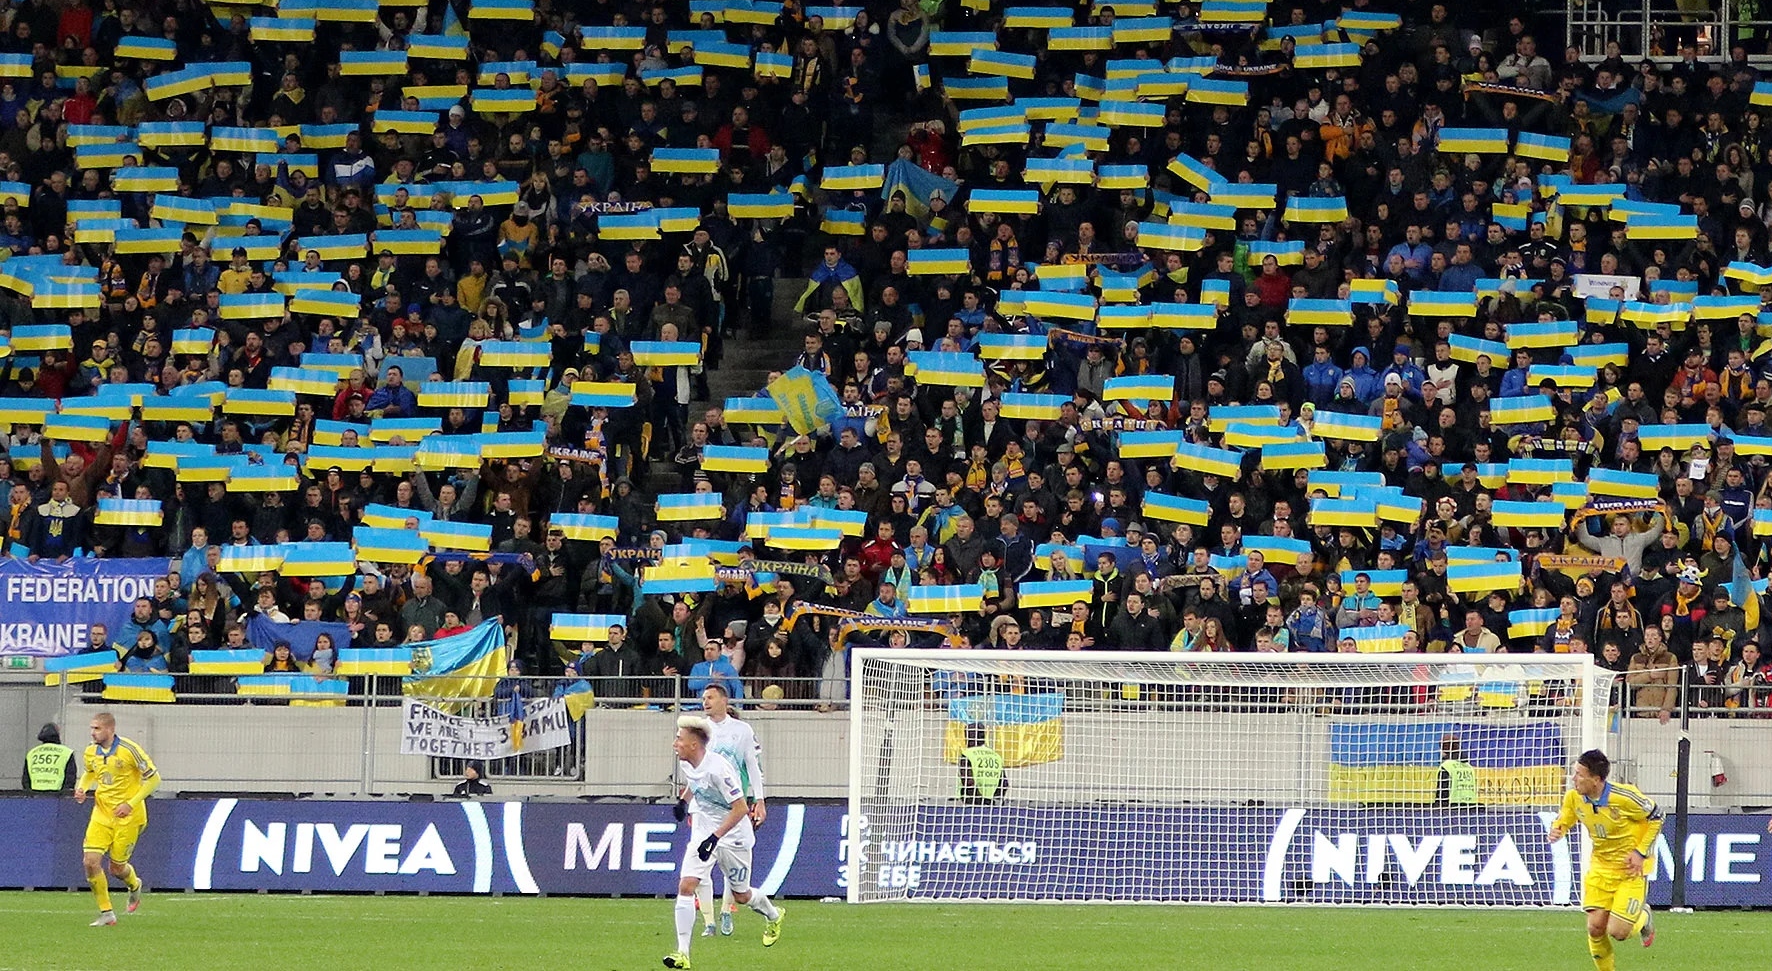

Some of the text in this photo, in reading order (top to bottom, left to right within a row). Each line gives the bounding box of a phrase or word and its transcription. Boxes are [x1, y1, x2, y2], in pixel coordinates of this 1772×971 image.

[580, 202, 652, 213] УКРАЇН
[1070, 254, 1136, 264] УКРАЇНА
[1588, 278, 1618, 287] WINNER
[846, 406, 885, 418] АЇНА
[1593, 500, 1659, 510] UKRAINE
[608, 548, 662, 560] УКРАЇН
[1550, 556, 1615, 566] УКРАЇНА
[751, 561, 820, 577] УКРАЇНА
[8, 577, 156, 603] FEDERATION
[860, 619, 928, 628] UKRAINE
[1, 623, 88, 649] KRAINE
[406, 736, 496, 757] TOGETHER
[31, 755, 61, 766] 2567
[977, 758, 1000, 769] 2305
[240, 818, 458, 876] NIVEA
[564, 822, 677, 872] ME
[1311, 829, 1536, 888] NIVEA
[728, 866, 748, 882] 20
[862, 865, 922, 889] ЕБЕ
[1627, 897, 1640, 915] 10
